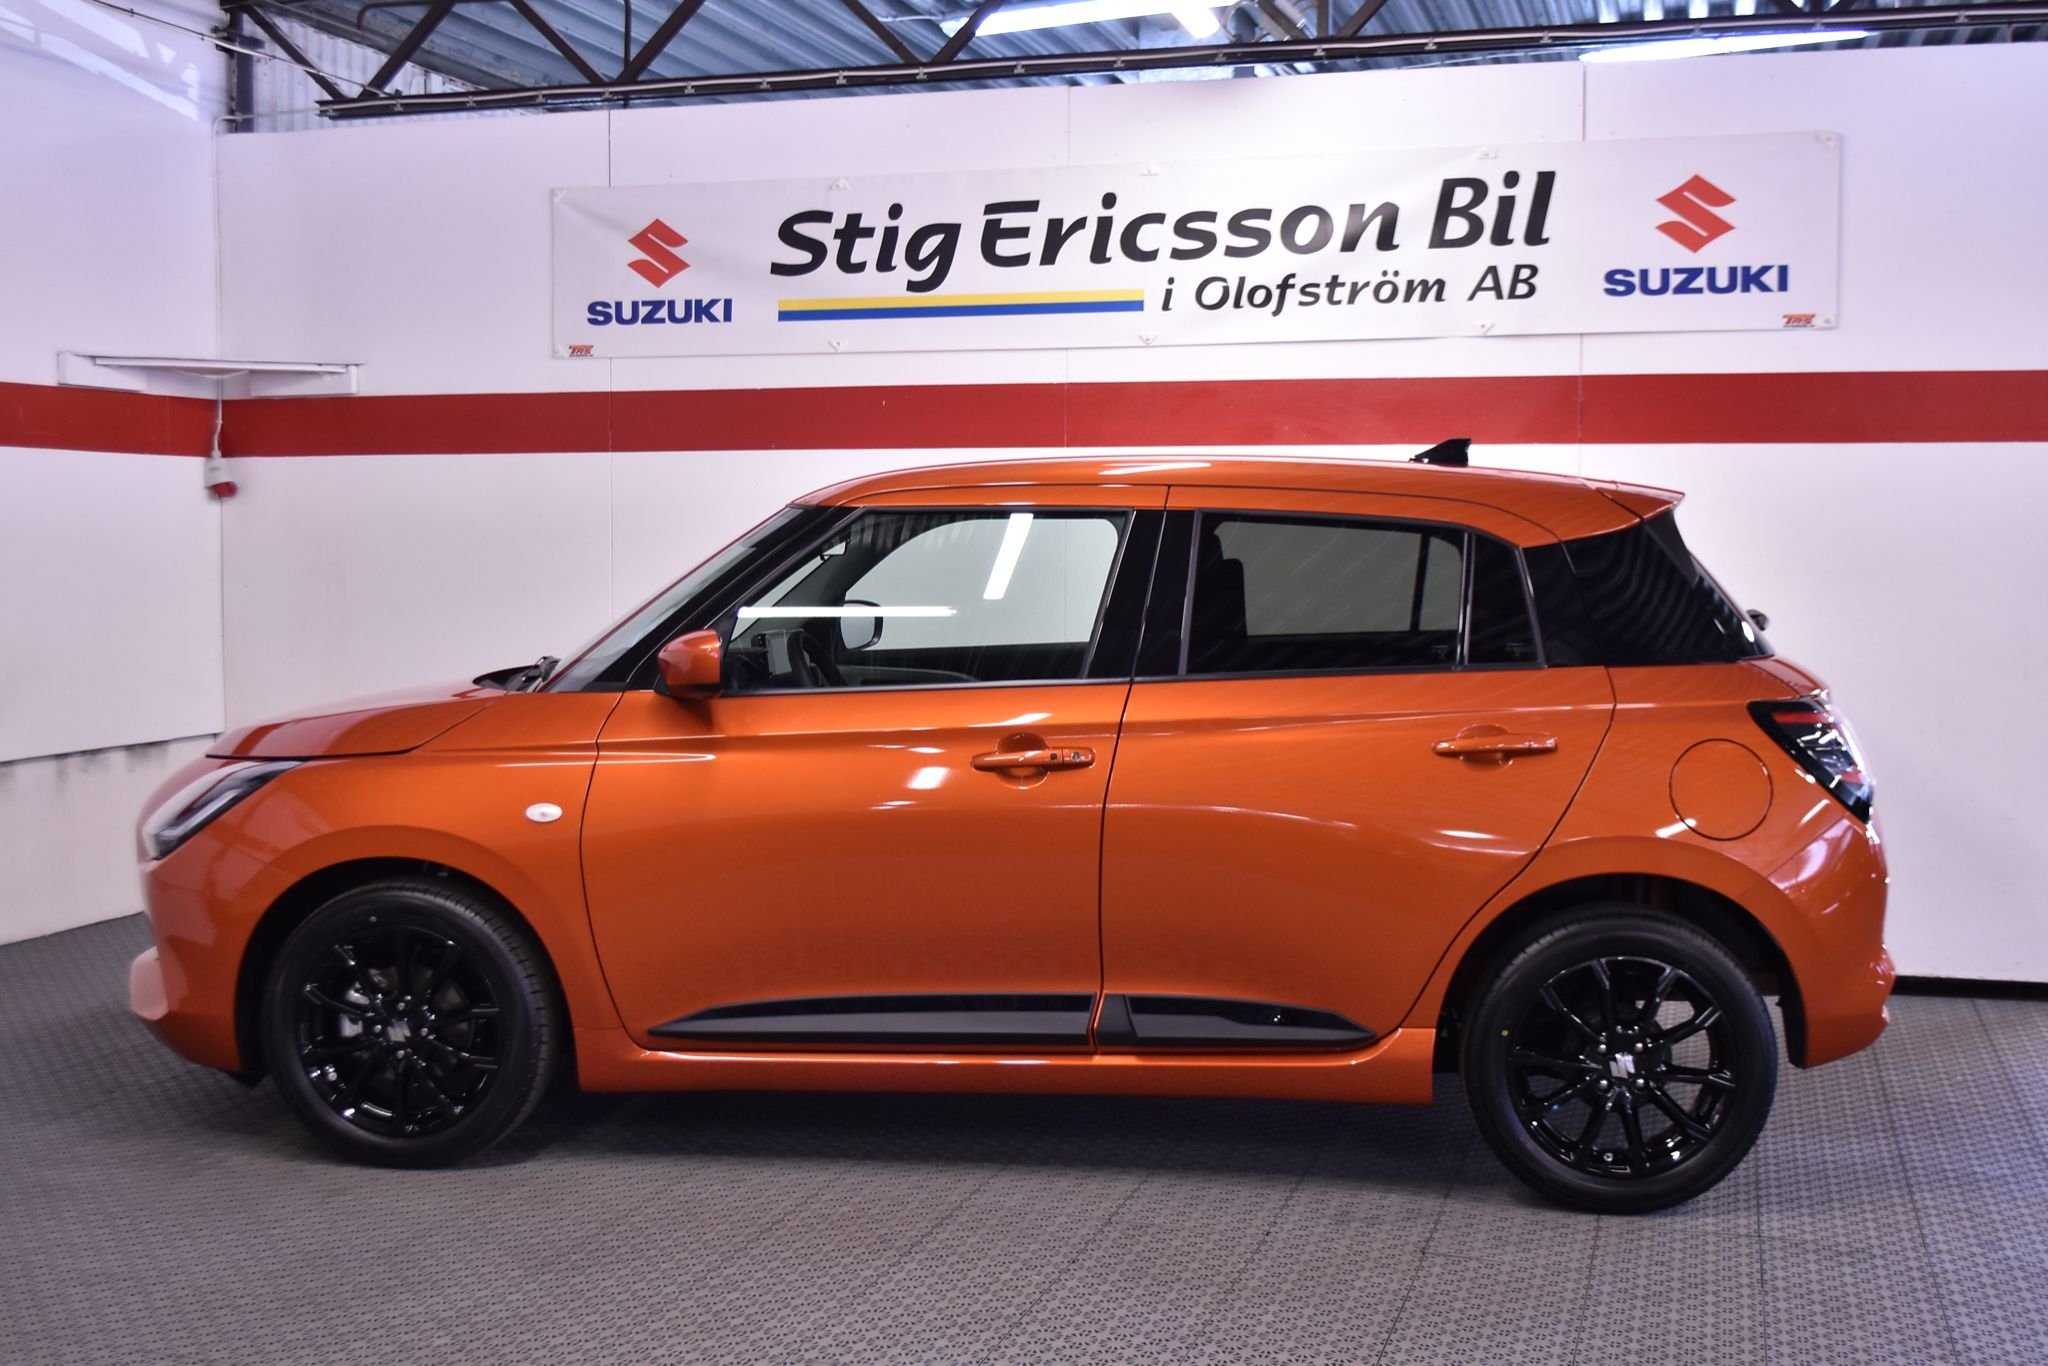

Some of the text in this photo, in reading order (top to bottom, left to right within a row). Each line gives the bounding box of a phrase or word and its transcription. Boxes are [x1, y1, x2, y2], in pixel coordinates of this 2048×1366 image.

[769, 170, 1556, 293] Stig Ericsson Bil
[1161, 263, 1539, 317] i Olofström AB
[1603, 264, 1789, 297] SUZUKI
[586, 298, 733, 326] SUZUKI
